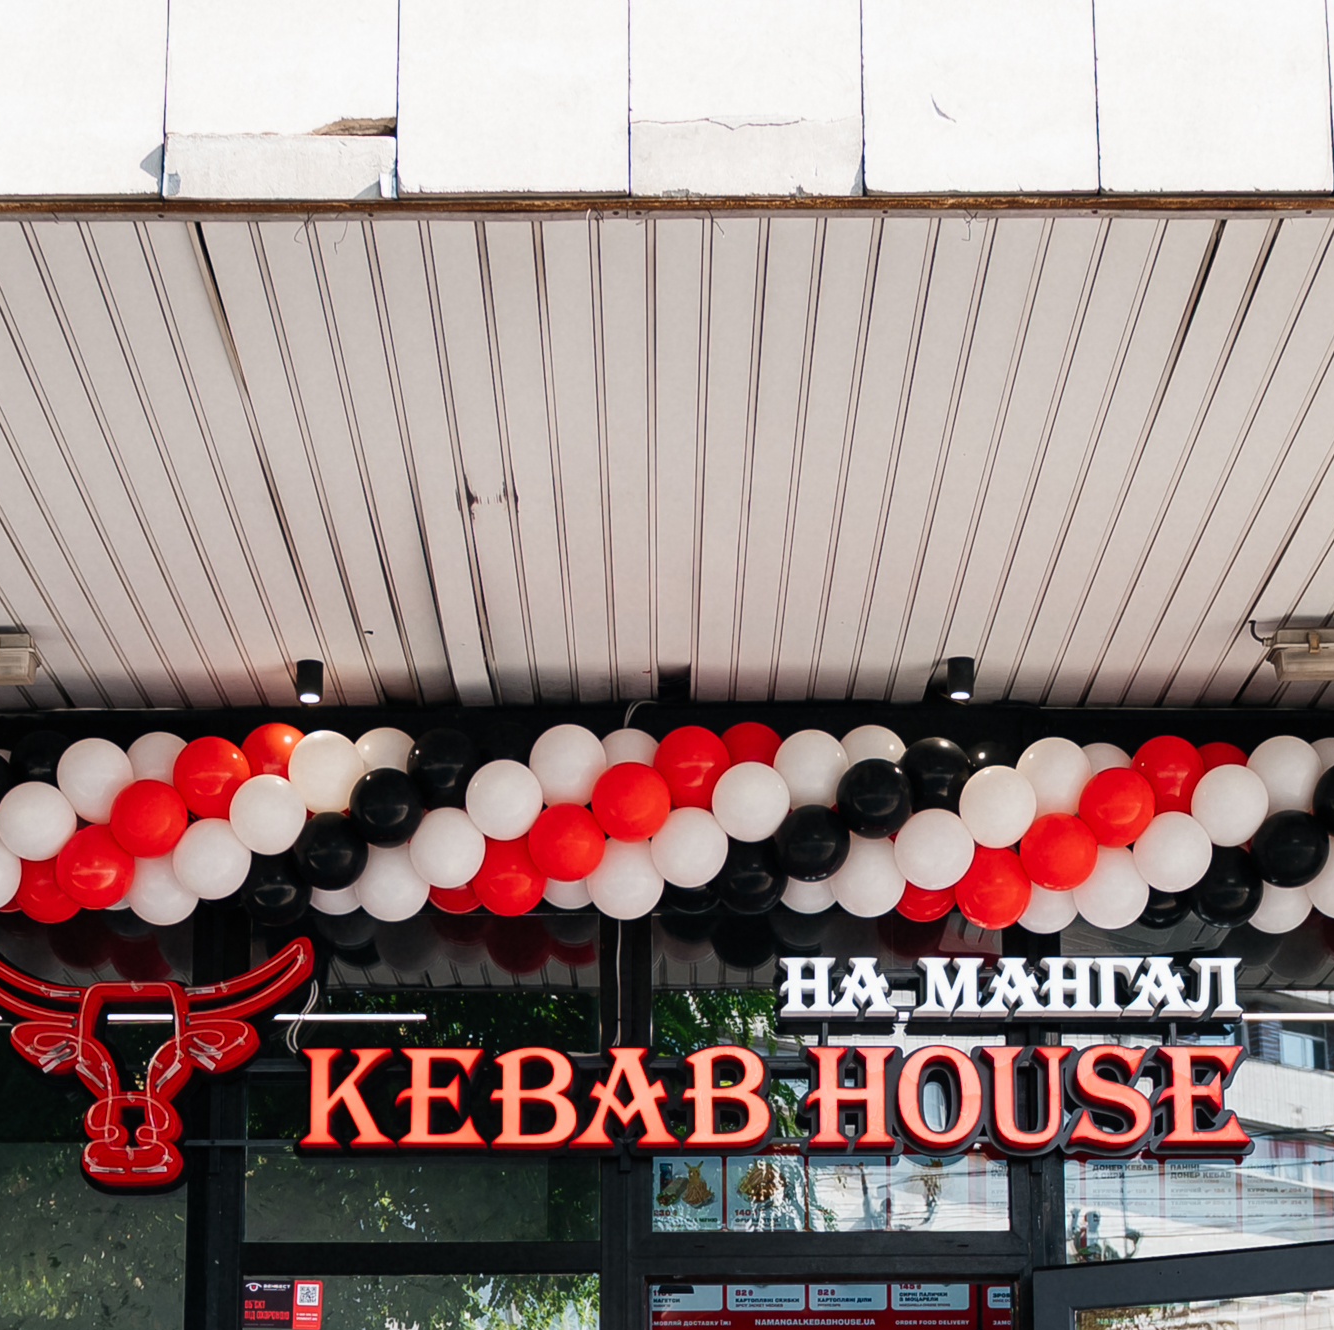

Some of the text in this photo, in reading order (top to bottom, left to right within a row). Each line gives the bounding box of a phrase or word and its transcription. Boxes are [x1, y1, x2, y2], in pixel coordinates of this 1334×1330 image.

[779, 957, 1243, 1017] НА МАНГАЛ
[299, 1045, 1252, 1149] KEBAB HOUSE
